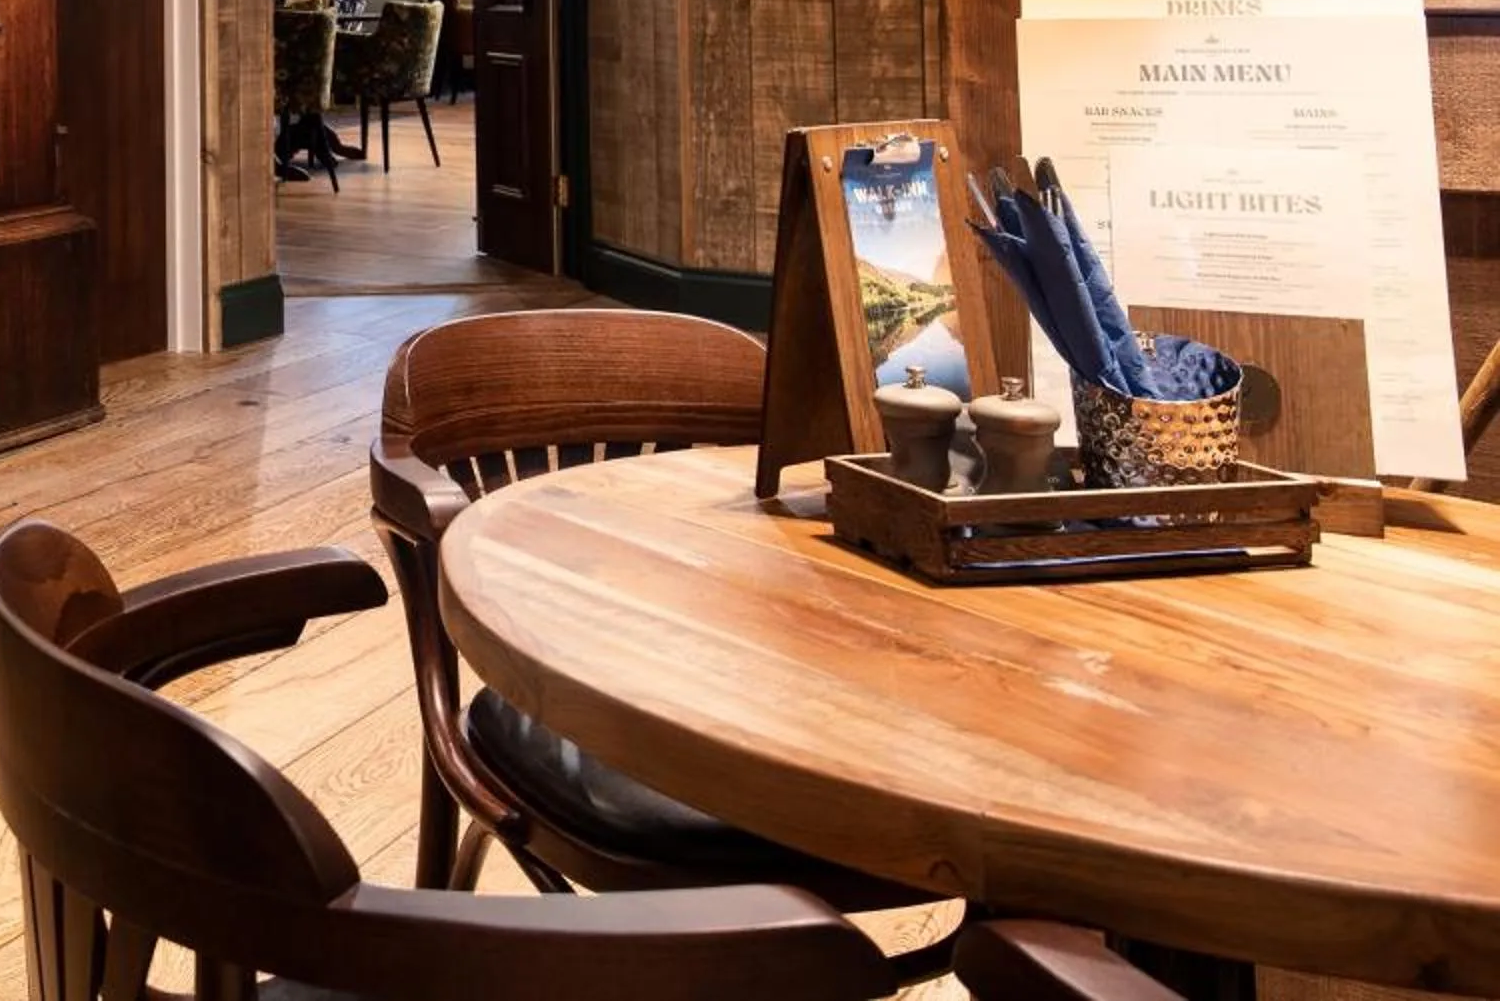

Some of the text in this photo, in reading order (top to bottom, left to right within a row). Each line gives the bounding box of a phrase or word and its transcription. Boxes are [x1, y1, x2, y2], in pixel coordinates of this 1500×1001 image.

[1139, 64, 1292, 82] MAIN MENU
[1149, 190, 1323, 214] LIGHT BITES
